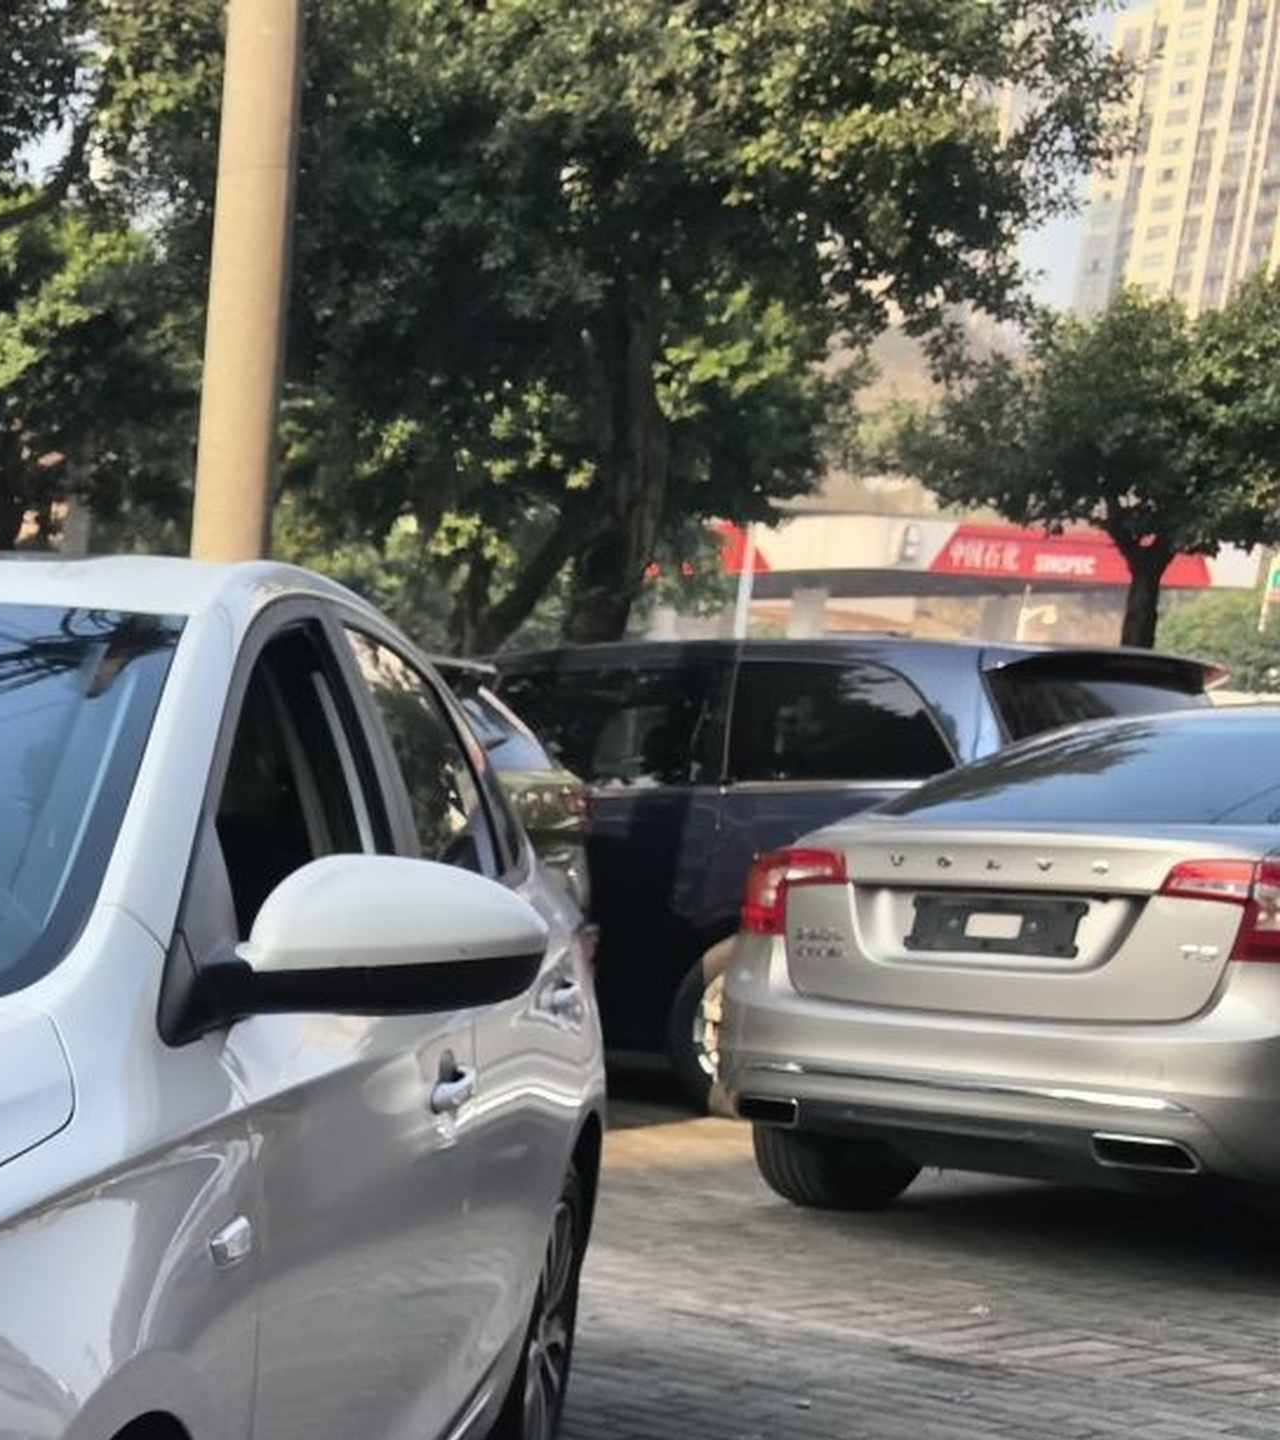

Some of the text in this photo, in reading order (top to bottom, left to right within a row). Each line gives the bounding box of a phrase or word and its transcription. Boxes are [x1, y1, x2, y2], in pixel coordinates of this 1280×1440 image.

[950, 539, 1097, 575] 中国石化 SINOPEC
[889, 853, 1110, 875] VOLVO
